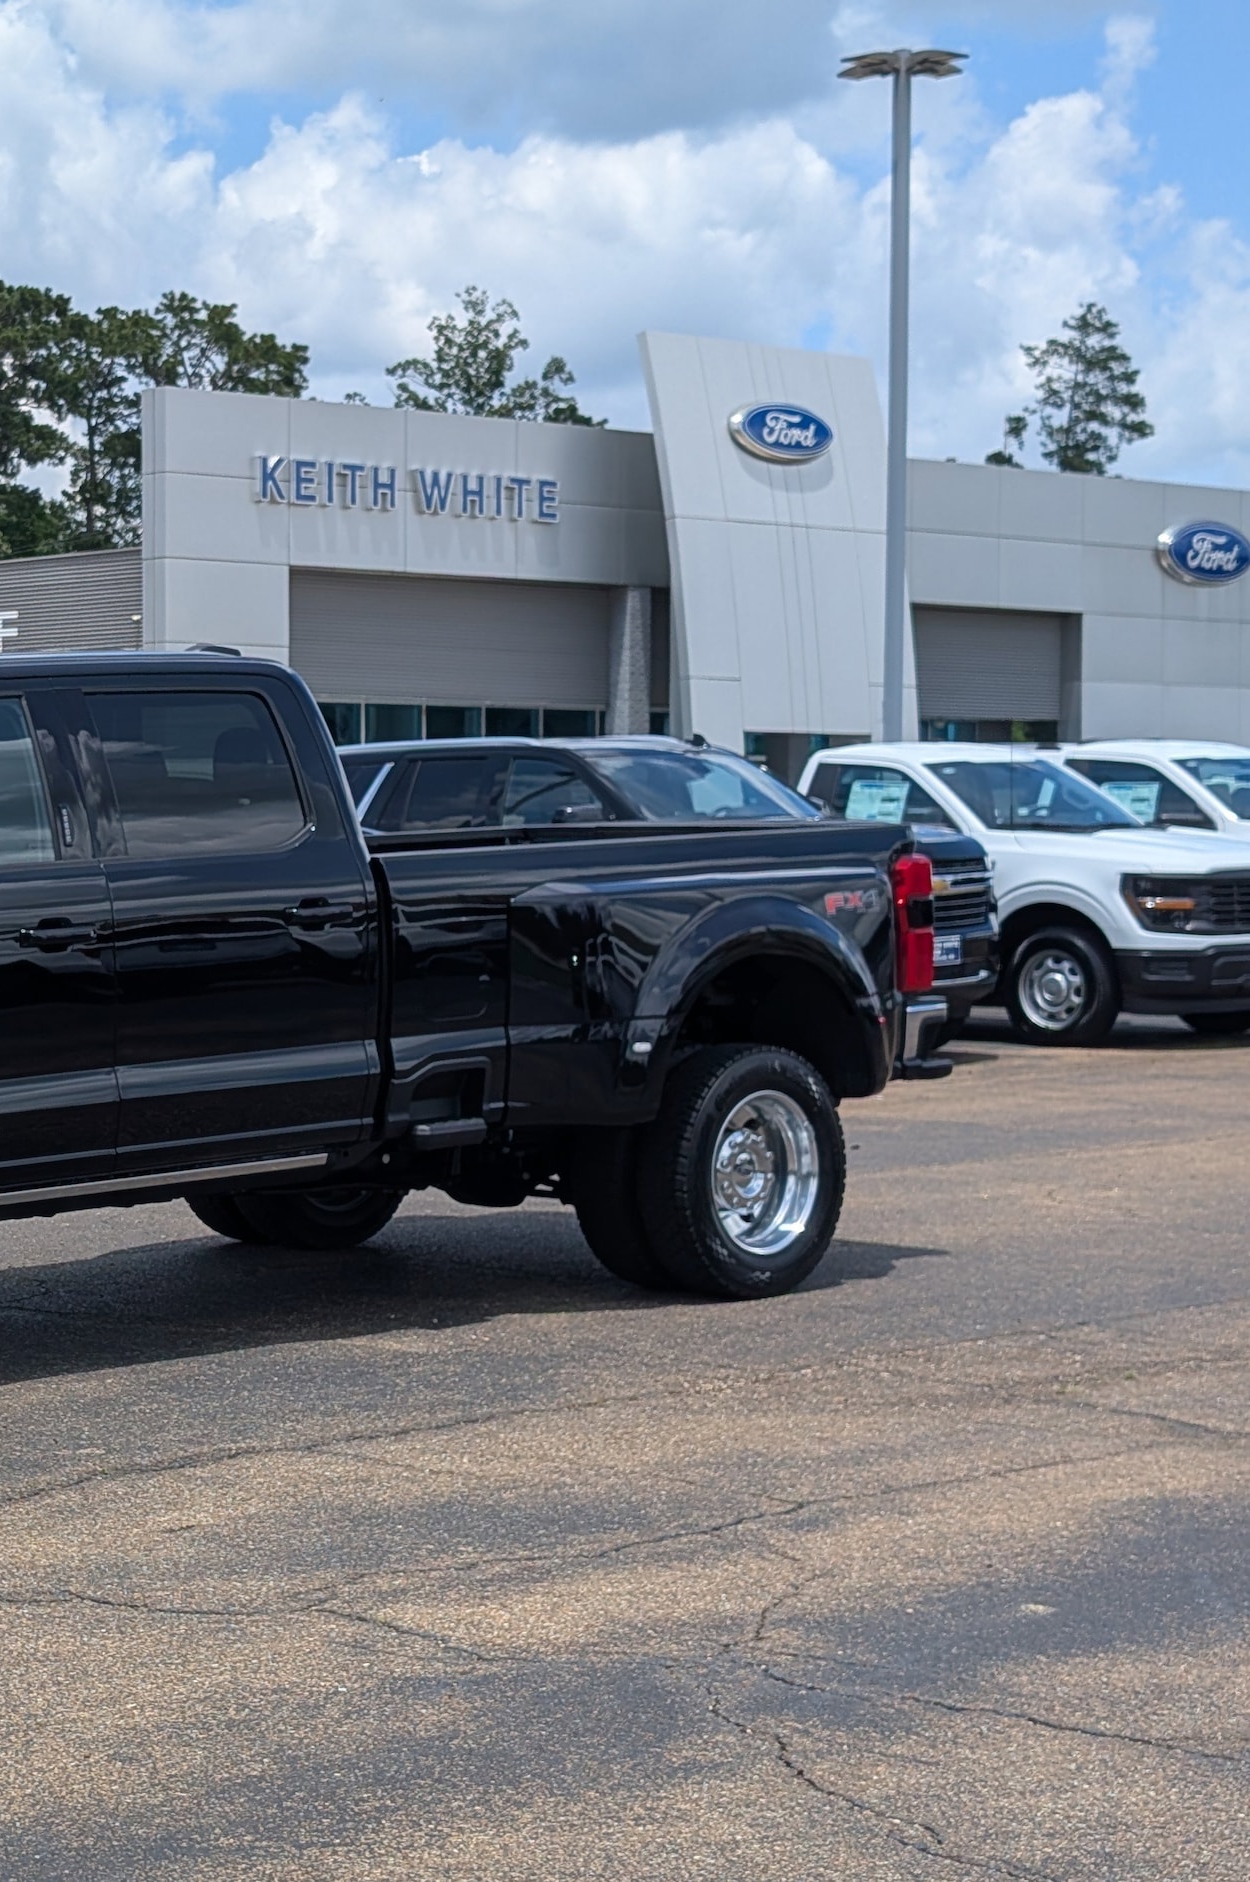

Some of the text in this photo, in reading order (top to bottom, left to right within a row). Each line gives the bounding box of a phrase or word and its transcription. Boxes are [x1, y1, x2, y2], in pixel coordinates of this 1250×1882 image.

[762, 410, 818, 447] Ford
[259, 455, 559, 523] KEITH WHITE
[1186, 531, 1242, 572] Ford
[824, 888, 880, 917] FX4
